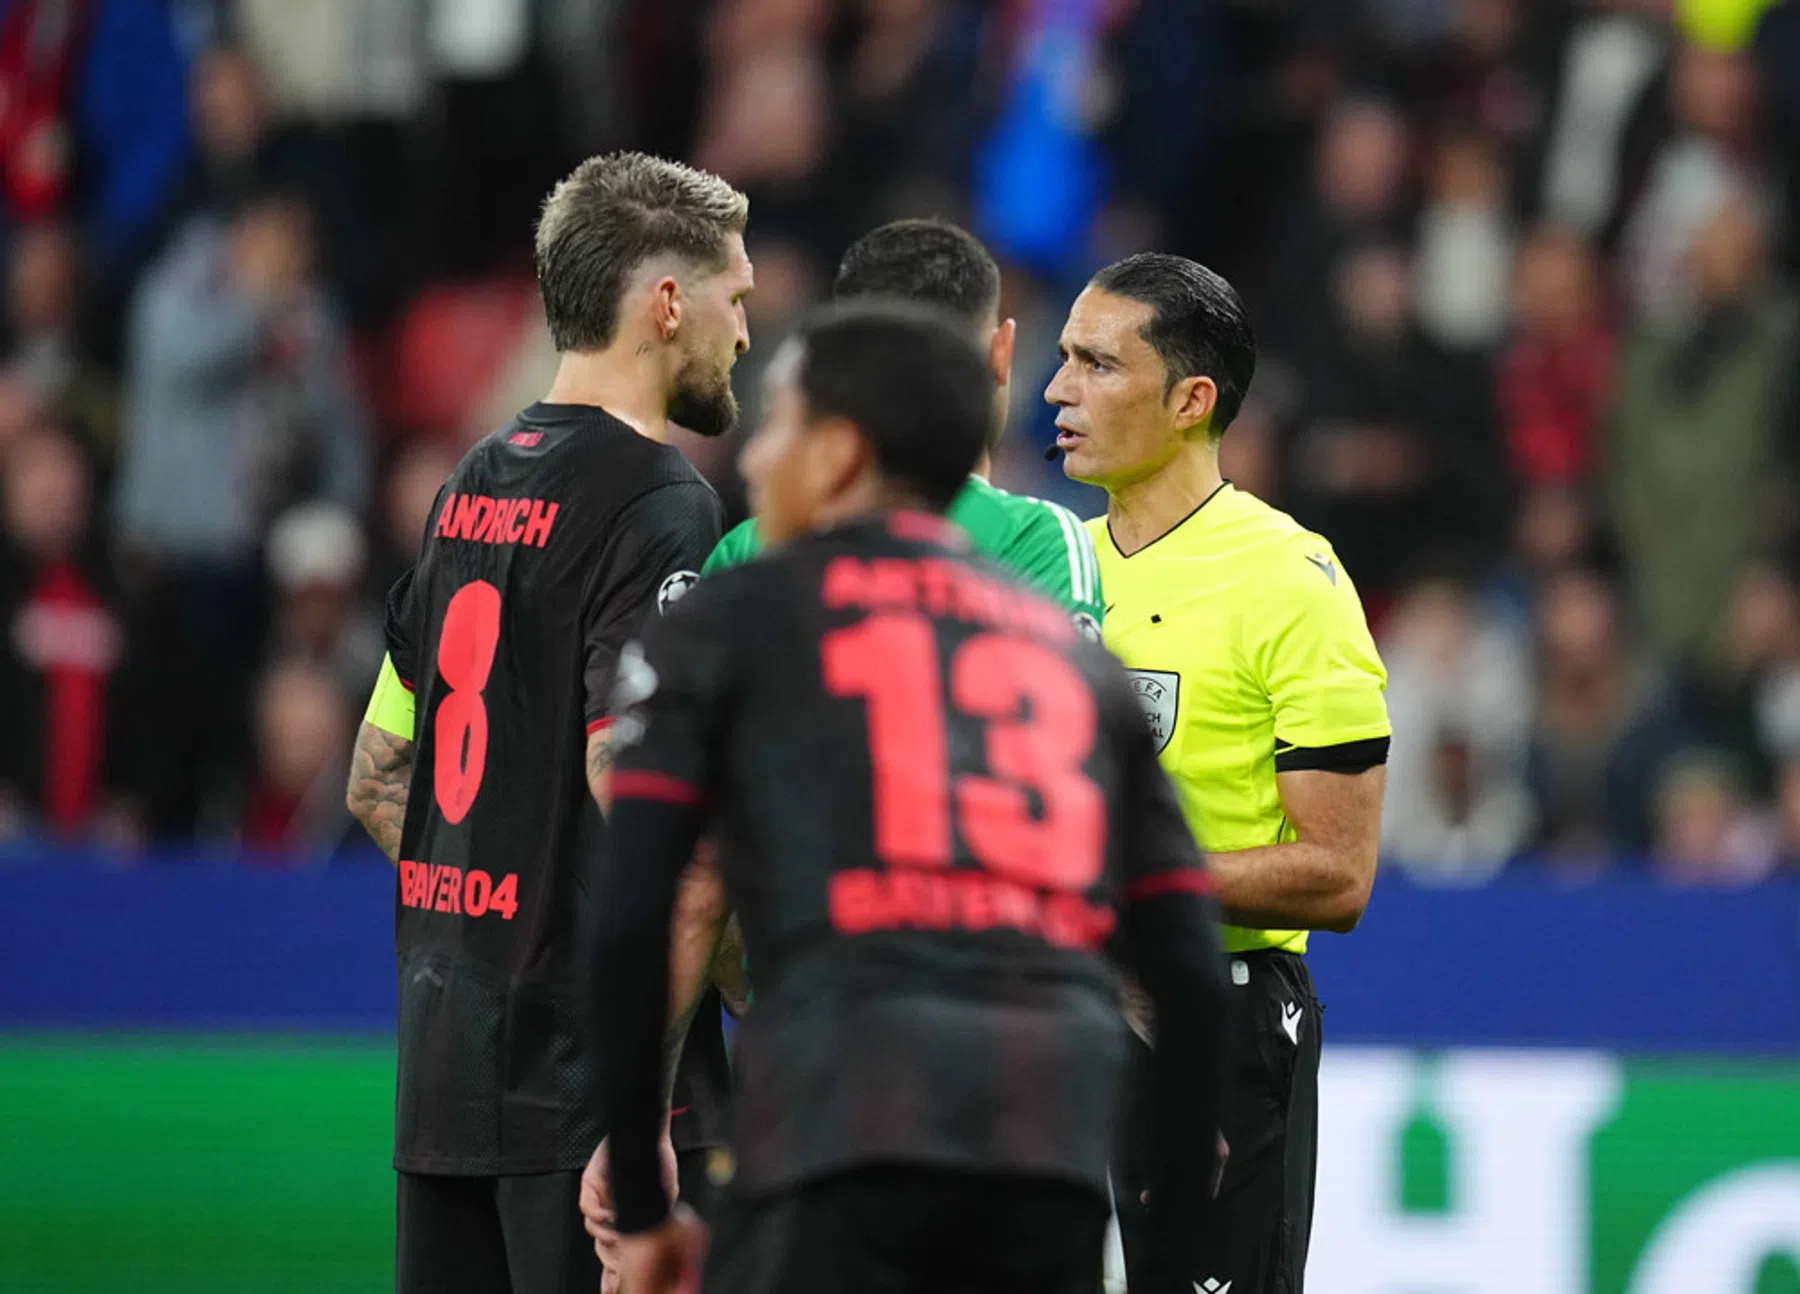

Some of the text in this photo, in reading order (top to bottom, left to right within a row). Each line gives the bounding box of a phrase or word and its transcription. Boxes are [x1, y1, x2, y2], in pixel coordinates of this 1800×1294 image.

[433, 491, 560, 549] ANDRICH
[434, 579, 502, 825] 8
[820, 608, 1108, 892] 13
[1132, 680, 1163, 699] EFA
